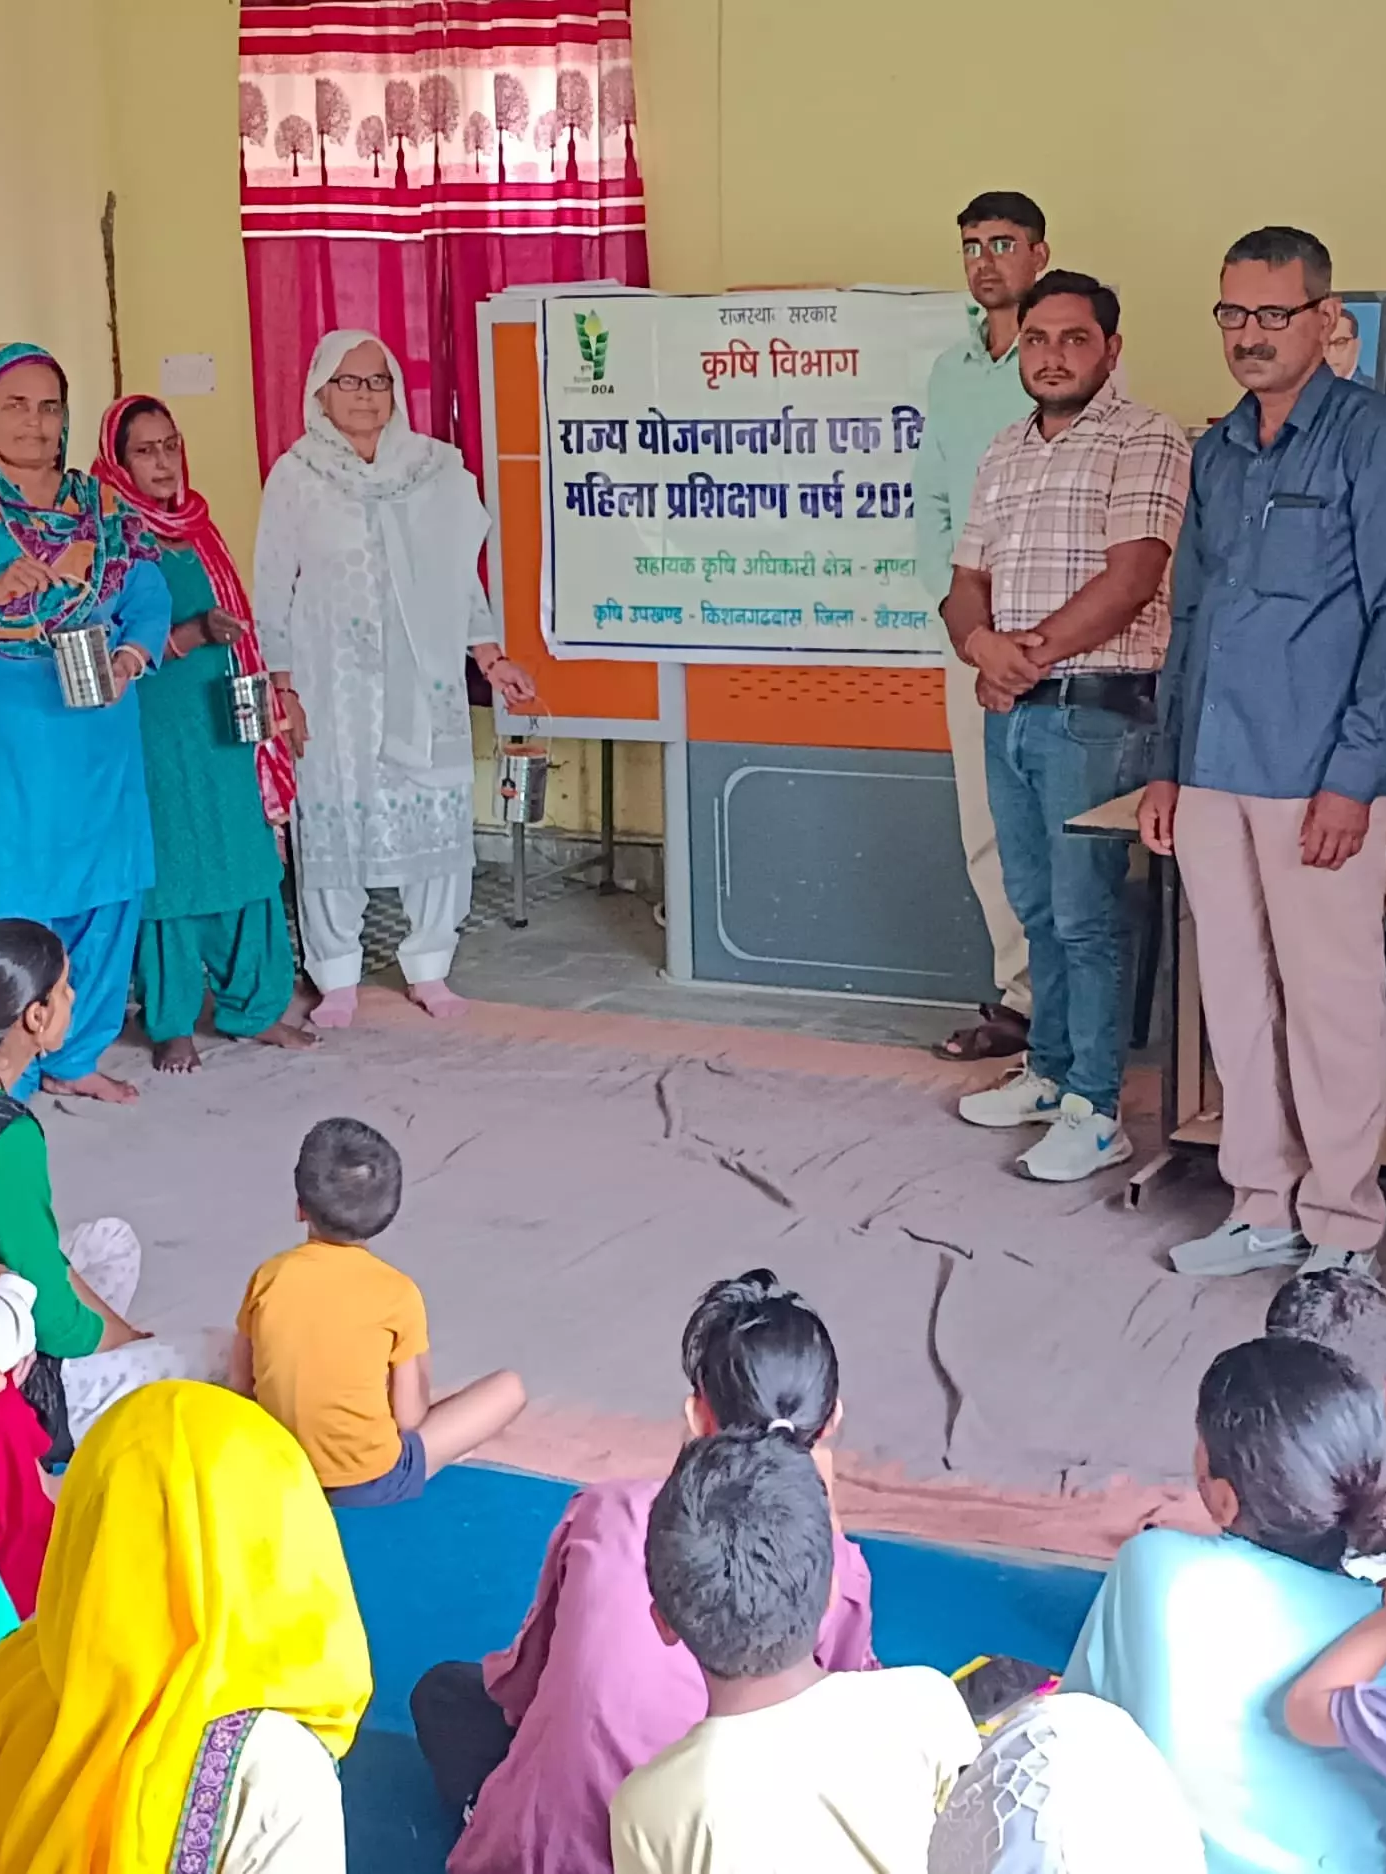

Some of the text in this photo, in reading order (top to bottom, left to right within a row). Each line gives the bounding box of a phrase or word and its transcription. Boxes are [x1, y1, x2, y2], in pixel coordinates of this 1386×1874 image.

[718, 305, 838, 326] राजस्था सरकार
[700, 337, 860, 390] कृषि विभाग
[591, 384, 615, 395] DOA
[558, 419, 629, 455] राज्य
[636, 406, 819, 455] योजनान्तर्गत
[826, 417, 883, 454] एक
[563, 471, 659, 518] महिला
[665, 471, 790, 520] प्रशिक्षण
[797, 469, 845, 519] वर्ष
[633, 556, 696, 577] सहायक
[701, 549, 737, 583] कृषि
[742, 549, 816, 577] अधिकारी
[822, 550, 853, 577] क्षेत्र
[873, 558, 917, 587] मुण्डा
[592, 596, 624, 630] कृषि
[628, 605, 683, 625] उपखण्ड
[814, 601, 854, 628] जिला
